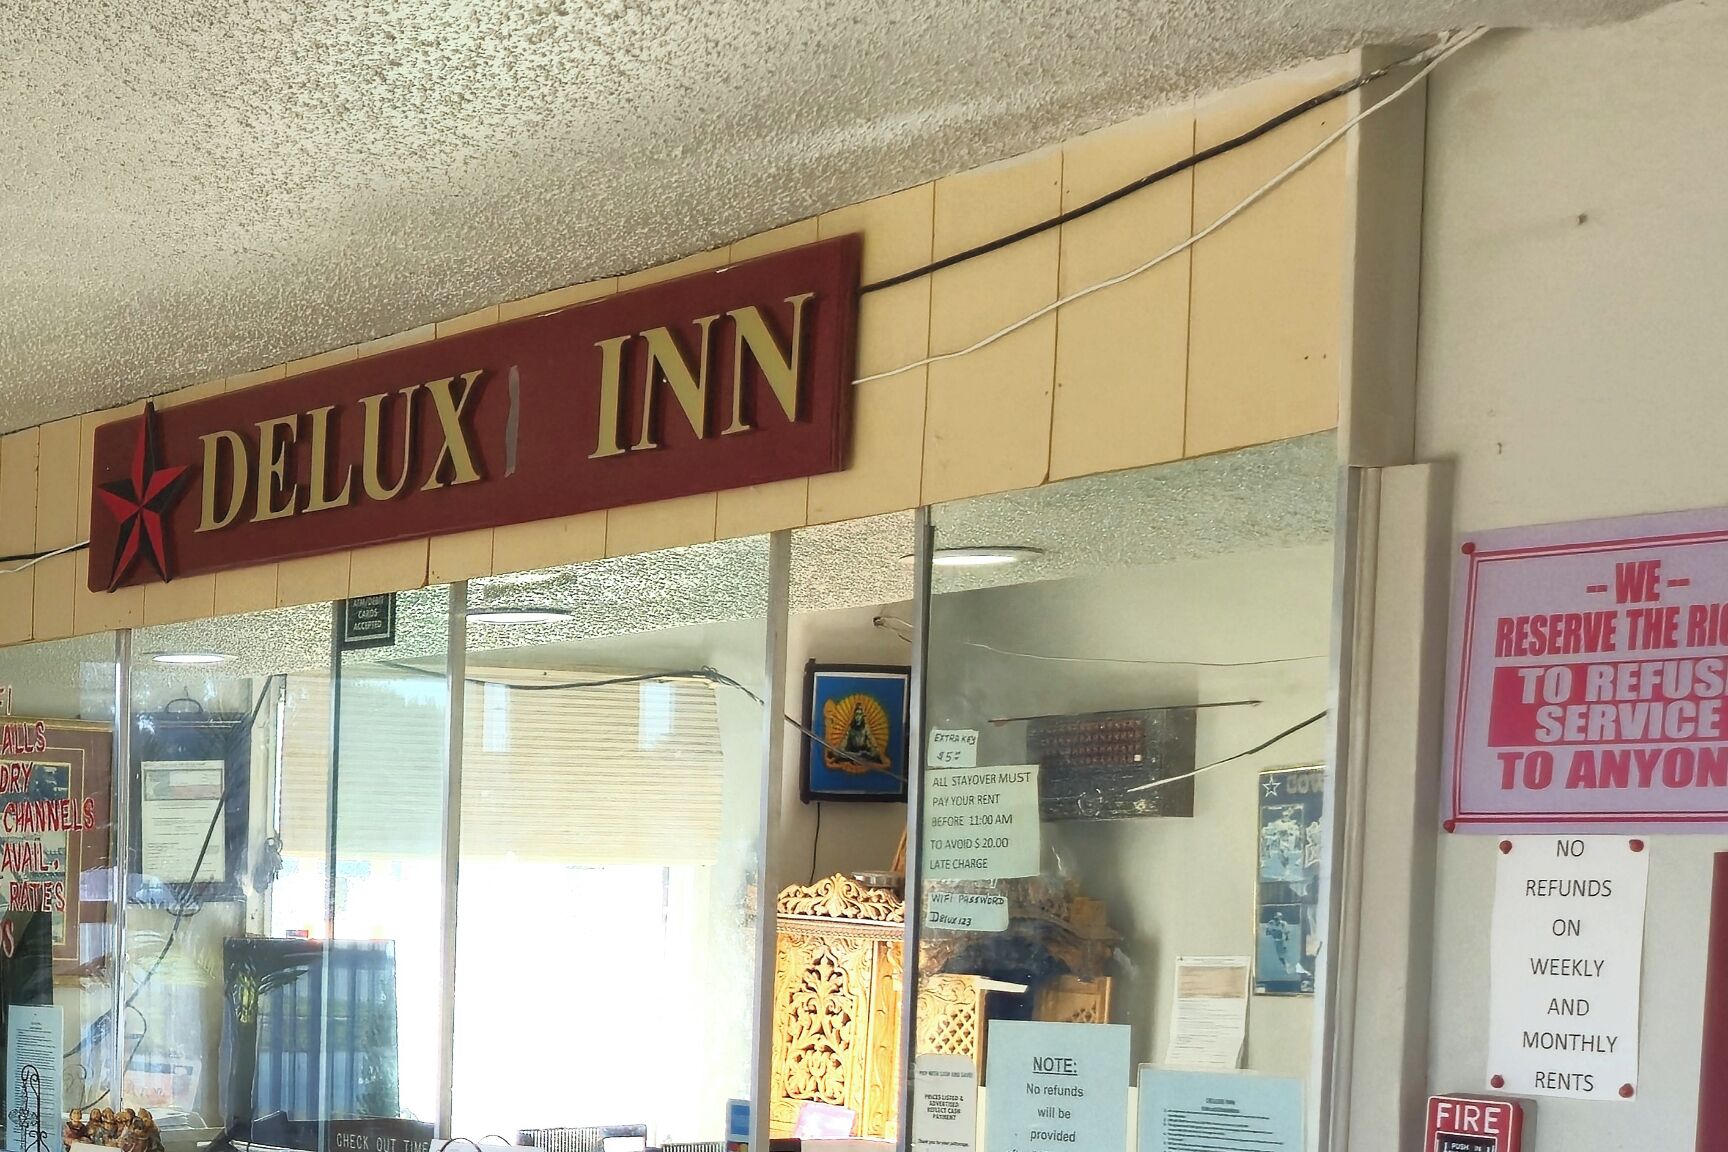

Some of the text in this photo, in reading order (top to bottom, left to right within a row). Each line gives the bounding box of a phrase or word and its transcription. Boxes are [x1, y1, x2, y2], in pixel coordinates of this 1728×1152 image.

[195, 292, 814, 534] DELUX INN
[1495, 611, 1617, 657] RESERVE
[1626, 606, 1680, 650] THE
[1519, 659, 1728, 703] TO REFUS
[1535, 700, 1721, 742] SERVICE
[932, 772, 1031, 787] ALL STAYOVER MUST
[1497, 751, 1554, 790] TO
[932, 794, 1000, 807] PAY YOUR RENT
[3, 798, 94, 832] CHANNELS
[931, 813, 1013, 827] BEFORE 11:00 AM
[931, 839, 942, 850] TO
[944, 838, 972, 849] AVOID
[1556, 839, 1585, 858] NO
[929, 858, 988, 870] LATE CHARGE
[10, 880, 65, 912] RATES
[1525, 879, 1613, 898] REFUNDS
[1552, 919, 1581, 938] ON
[1530, 958, 1605, 978] WEEKLY
[1547, 998, 1590, 1017] AND
[1522, 1031, 1618, 1054] MONTHLY
[1032, 1056, 1078, 1075] NOTE:
[1026, 1083, 1084, 1098] No refunds
[1534, 1071, 1594, 1092] RENTS
[1037, 1107, 1071, 1119] will be
[1436, 1102, 1501, 1134] FIRE
[336, 1133, 369, 1150] CHECK
[376, 1137, 396, 1152] OUT
[1030, 1130, 1076, 1142] provided
